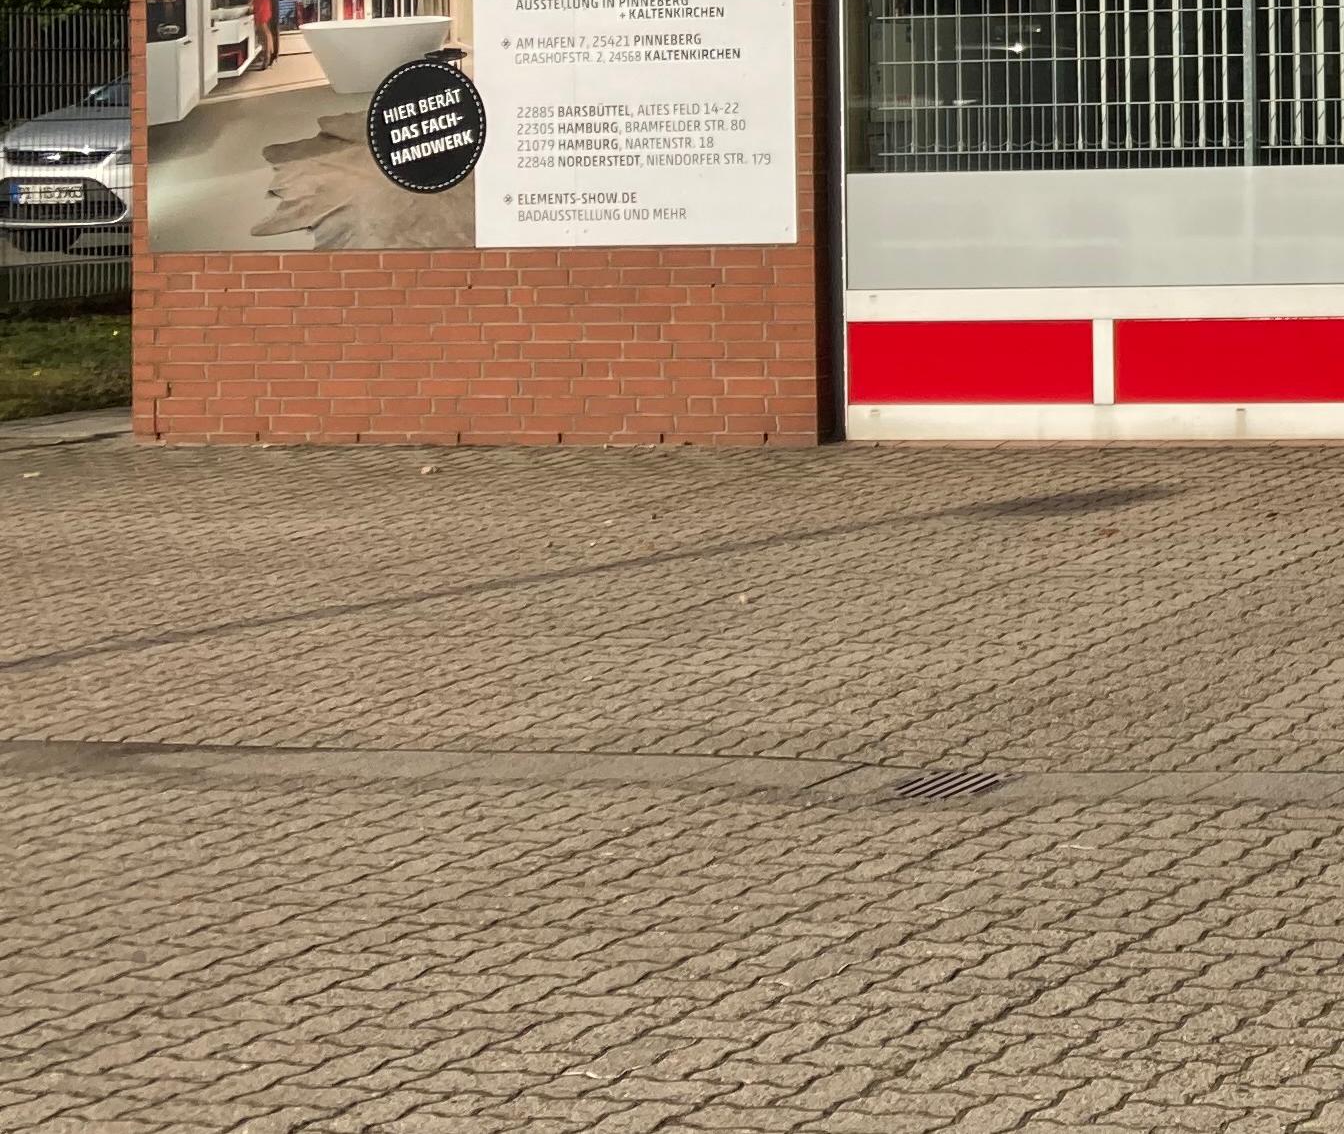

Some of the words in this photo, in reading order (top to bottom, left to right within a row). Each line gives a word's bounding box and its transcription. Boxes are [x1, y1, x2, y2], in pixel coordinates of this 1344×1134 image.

[628, 6, 725, 20] KALTENKIRCHEN
[516, 37, 534, 49] AM
[537, 36, 575, 49] HAFEN
[592, 34, 630, 48] 25421
[633, 33, 702, 47] PINNEBERG
[644, 47, 741, 62] KALTENKIRCHEN
[382, 102, 417, 125] HIER
[418, 88, 461, 114] BERÄT
[516, 106, 555, 119] 22885
[637, 104, 670, 117] ALTES
[672, 103, 700, 116] FELD
[703, 102, 739, 115] 14-22
[390, 123, 420, 144] DAS
[421, 112, 464, 135] FACH-
[516, 122, 555, 136] 22305
[557, 121, 622, 135] HAMBURG,
[624, 119, 701, 133] BRAMFELDER
[730, 119, 746, 131] 80
[389, 129, 474, 166] HANDWERK
[516, 139, 555, 152] 21079
[558, 138, 622, 151] HAMBURG,
[698, 136, 714, 149] 18
[516, 155, 555, 168] 22848
[646, 153, 720, 167] NIENDORFER
[751, 153, 772, 166] 179
[517, 192, 638, 206] ELEMENTS-SHOW.DE
[517, 208, 621, 222] BADAUSSTELLUNG
[623, 208, 650, 221] UND
[652, 207, 687, 220] MEHR
